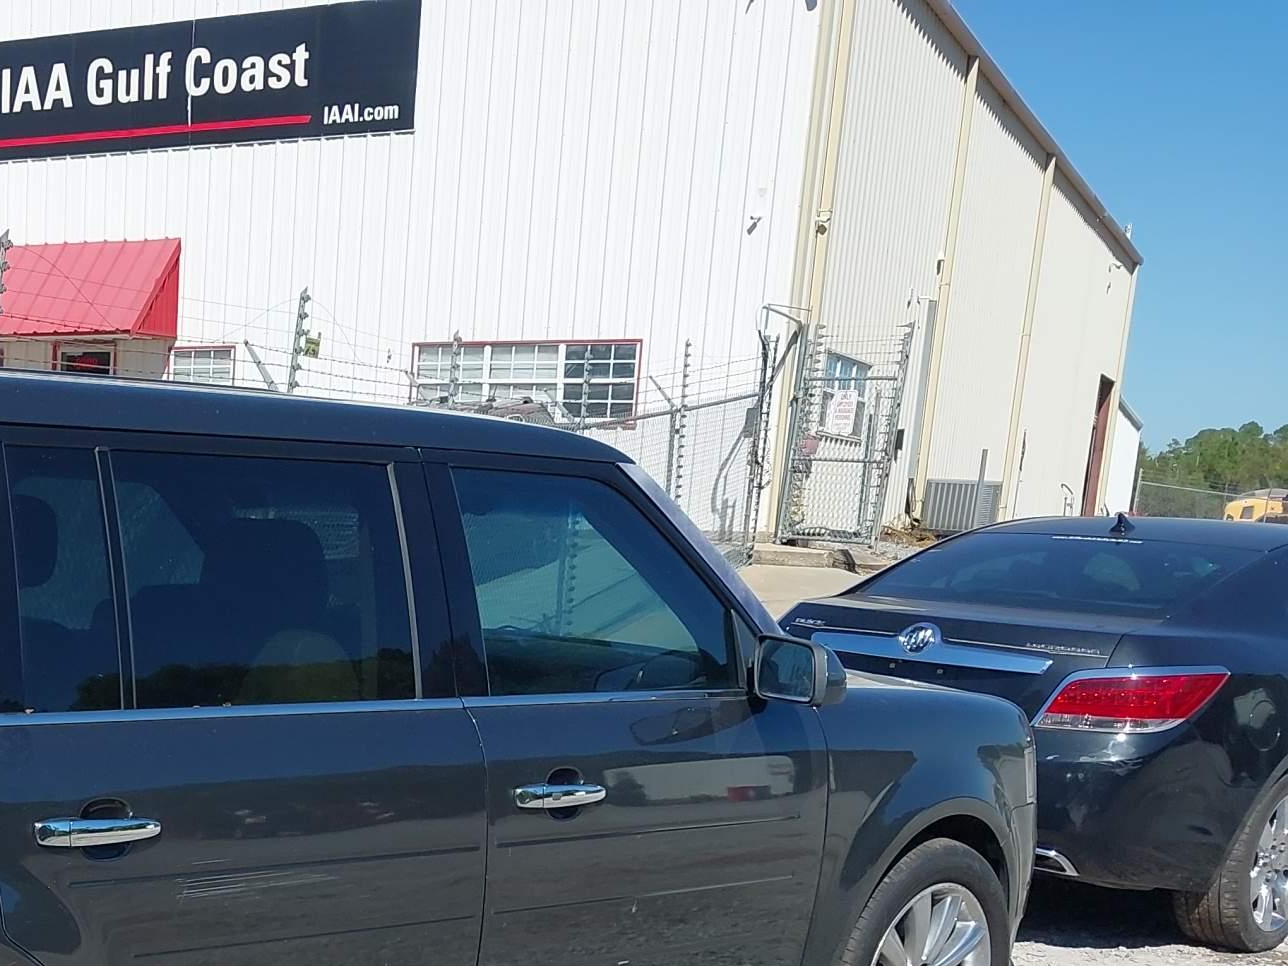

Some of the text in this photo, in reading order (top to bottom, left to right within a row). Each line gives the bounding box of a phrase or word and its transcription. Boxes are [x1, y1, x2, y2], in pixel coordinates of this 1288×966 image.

[0, 43, 309, 113] IAA Gulf Coast
[323, 103, 399, 125] IAAI.com
